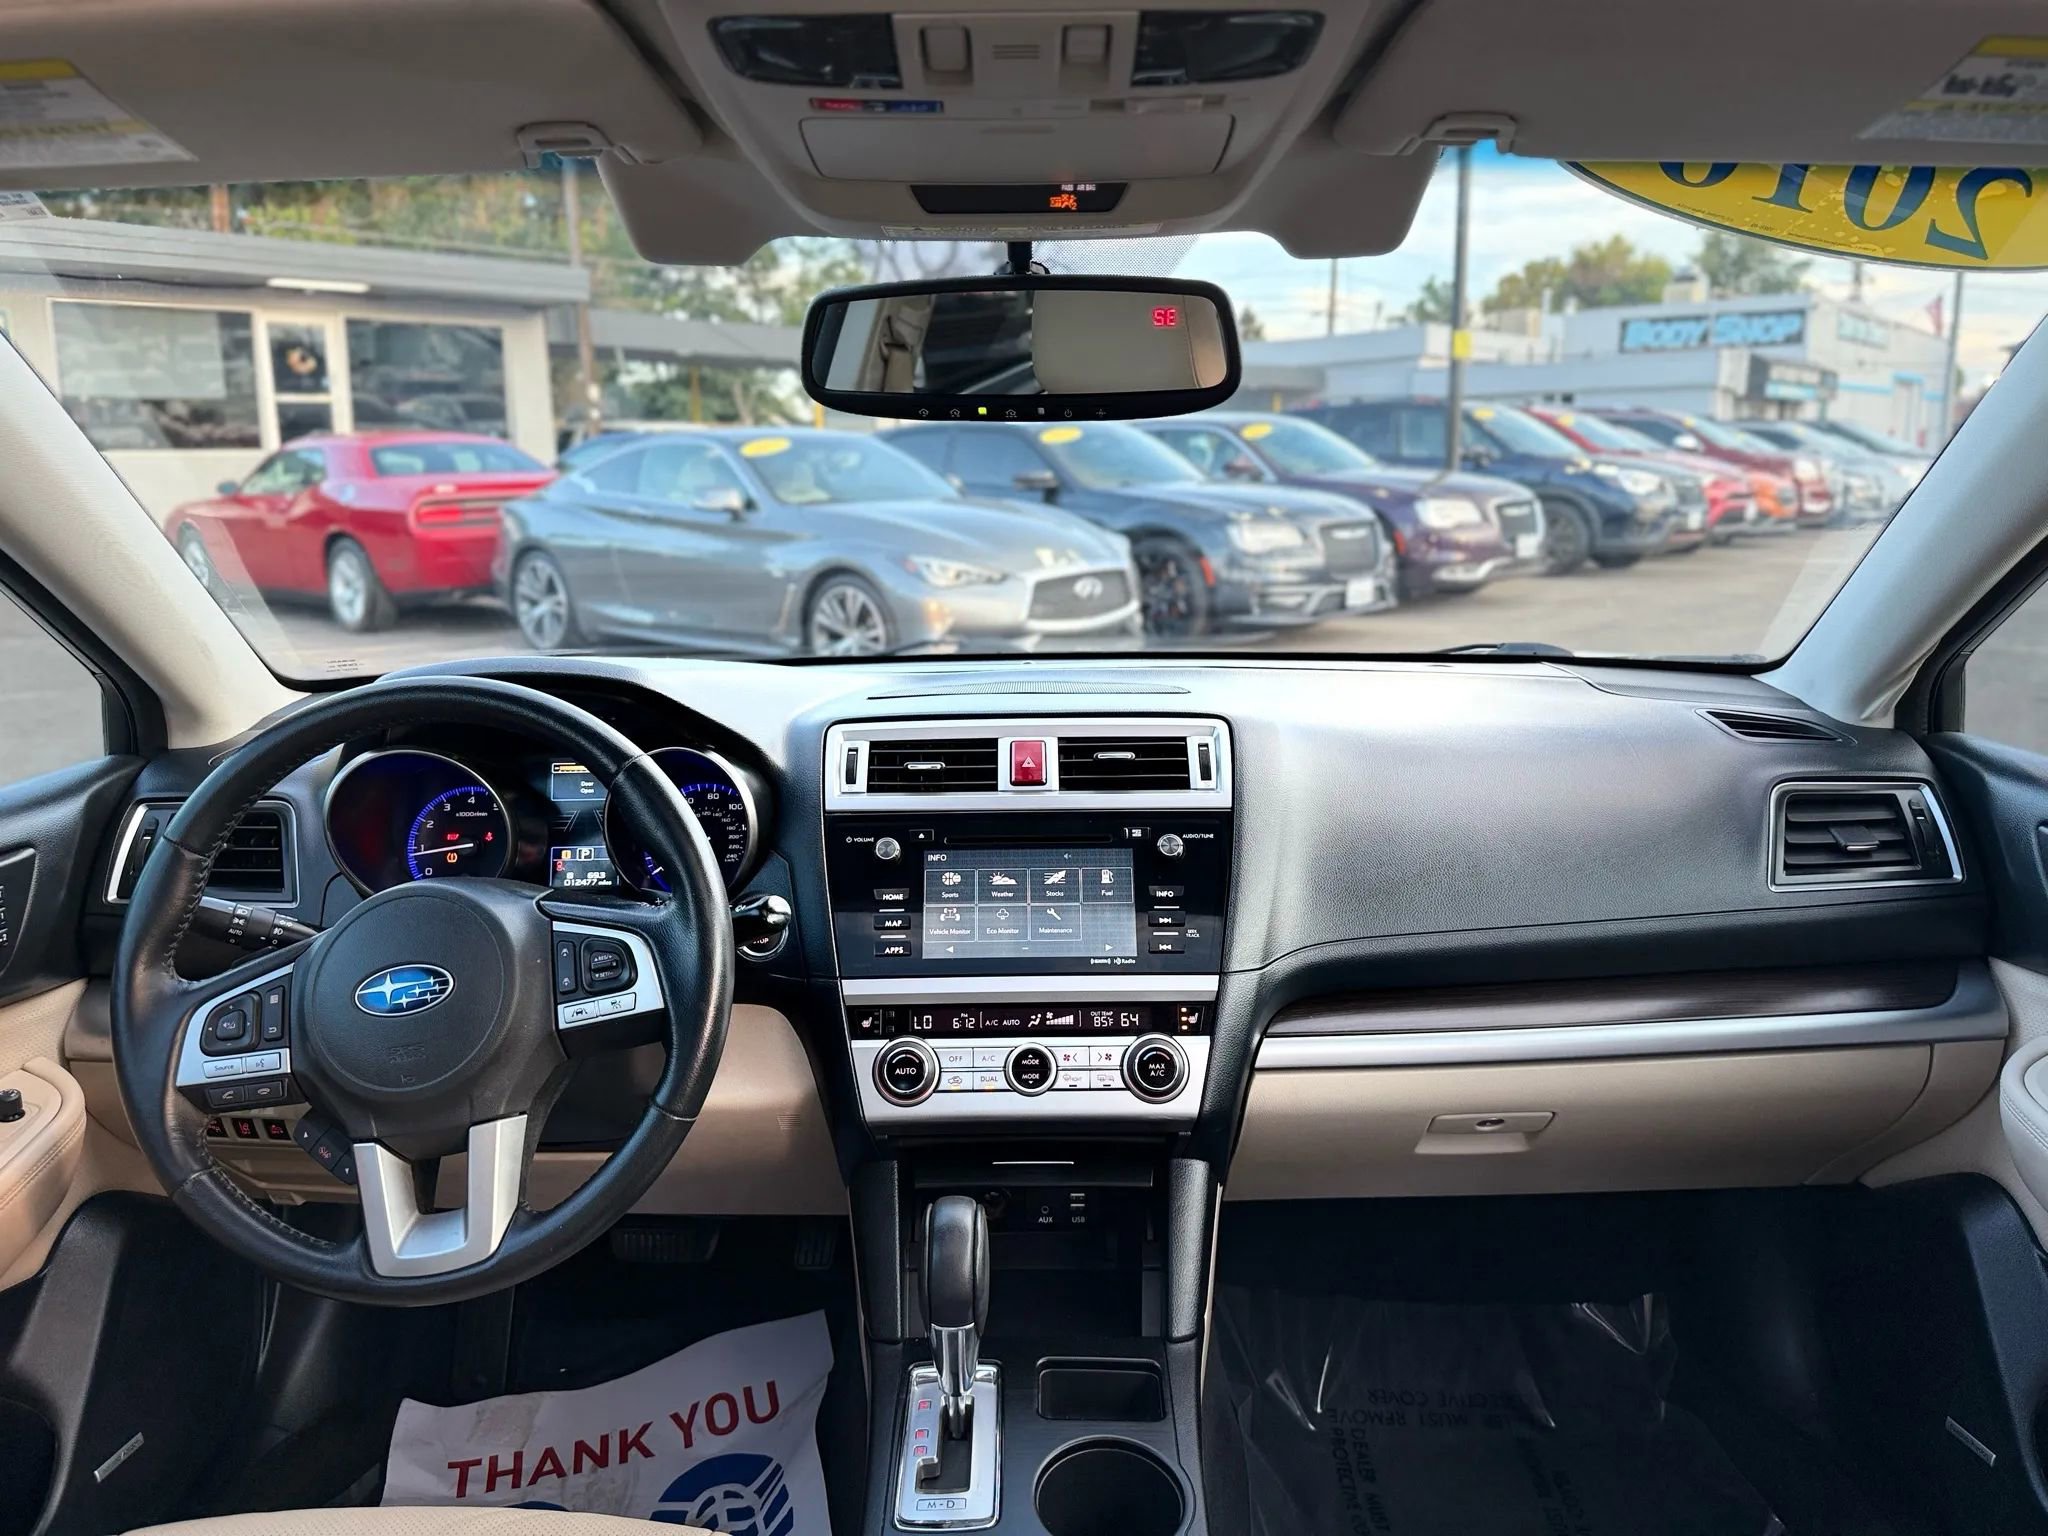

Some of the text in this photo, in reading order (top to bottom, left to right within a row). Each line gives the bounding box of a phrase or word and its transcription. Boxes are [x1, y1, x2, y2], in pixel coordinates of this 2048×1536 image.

[1154, 309, 1176, 326] SE
[1713, 311, 1804, 347] SHOP
[467, 796, 475, 804] 4
[443, 803, 451, 811] 3
[426, 820, 434, 828] 2
[927, 854, 947, 862] INFO
[425, 867, 433, 876] 0
[882, 893, 904, 901] HOME
[941, 891, 959, 899] Sports
[991, 890, 1014, 898] Weather
[1156, 890, 1174, 898] INFO
[884, 919, 903, 927] MAP
[1039, 926, 1073, 934] Maintenance
[884, 946, 904, 954] APPS
[952, 1017, 975, 1029] 6:12
[1120, 1012, 1139, 1027] 64
[948, 1055, 963, 1063] OFF
[214, 1064, 235, 1072] Source
[894, 1067, 917, 1075] AUTO
[980, 1075, 999, 1083] DUAL
[447, 1380, 781, 1499] THANK YOU
